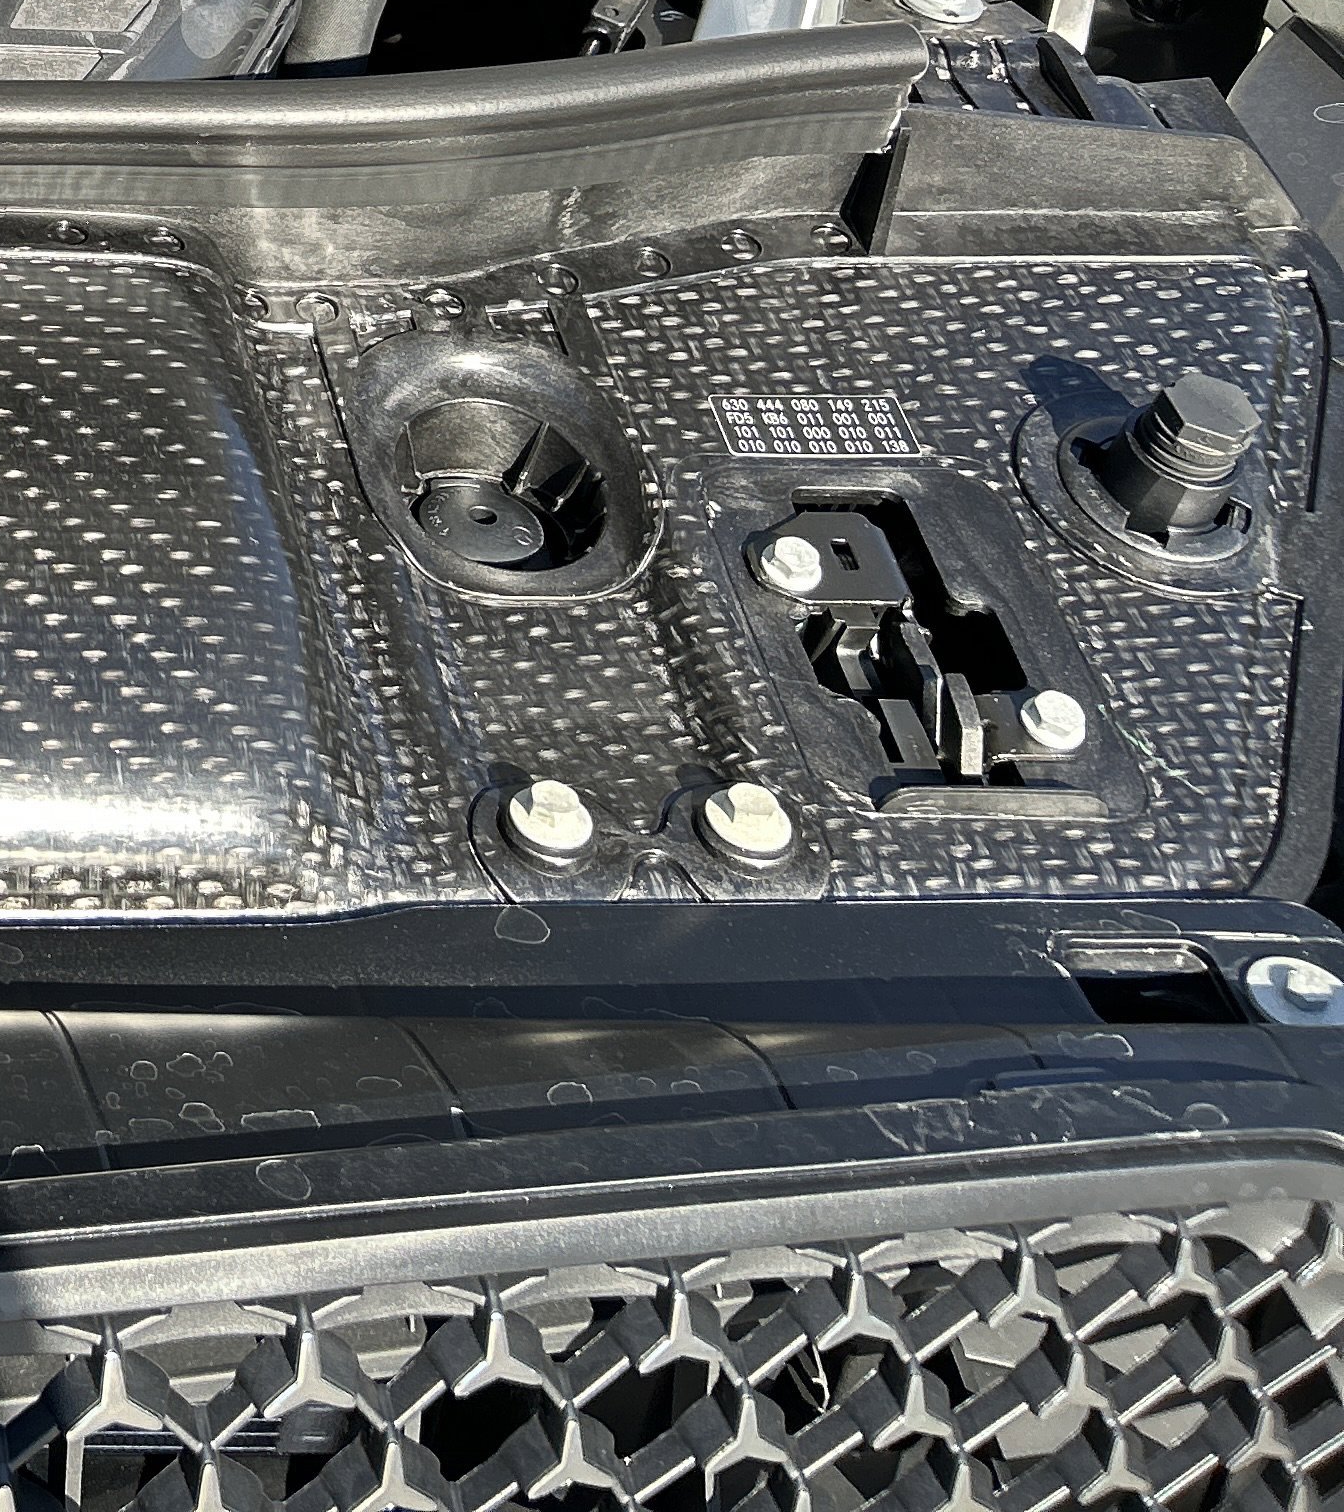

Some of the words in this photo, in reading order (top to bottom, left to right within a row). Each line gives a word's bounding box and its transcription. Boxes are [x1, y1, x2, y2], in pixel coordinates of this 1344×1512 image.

[722, 399, 748, 411] 630
[757, 399, 784, 411] 444
[791, 399, 819, 411] 080
[828, 399, 853, 411] 149
[861, 399, 889, 411] 215
[726, 412, 753, 425] FD5
[762, 412, 789, 425] KB6
[797, 412, 823, 425] 011
[832, 412, 859, 425] 001
[868, 412, 895, 425] 001
[734, 426, 759, 438] 101
[769, 426, 794, 438] 101
[803, 427, 831, 439] 000
[839, 426, 868, 439] 010
[874, 426, 901, 438] 011
[738, 439, 766, 452] 010
[774, 440, 801, 453] 010
[809, 441, 837, 453] 010
[845, 440, 873, 453] 010
[882, 440, 909, 453] 138
